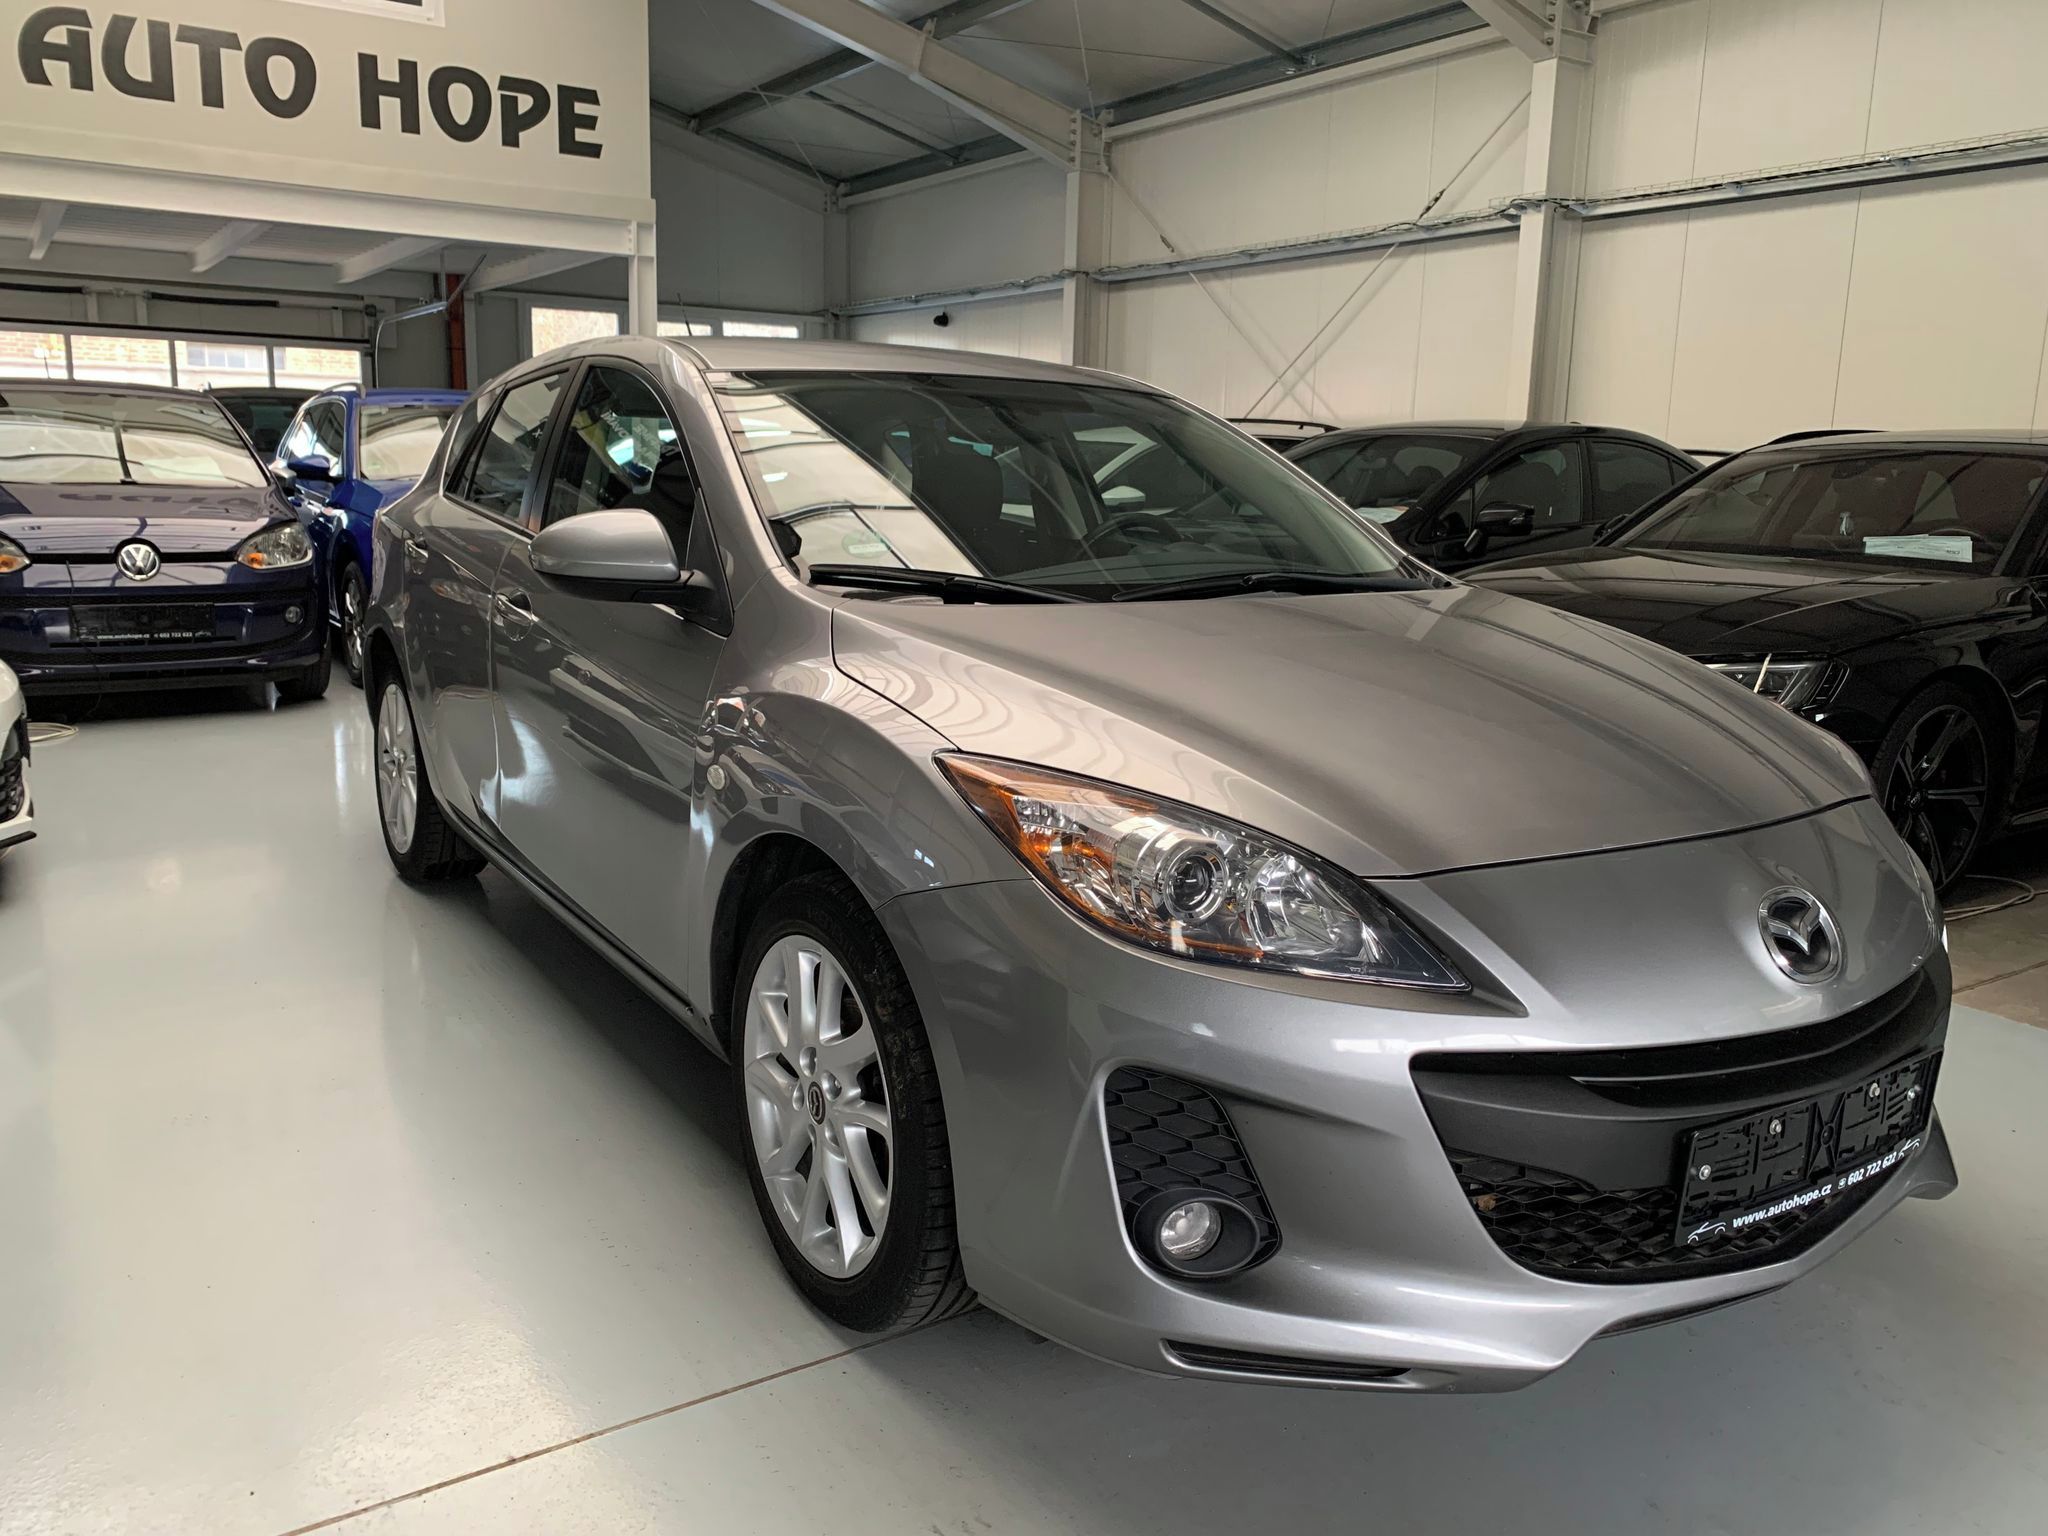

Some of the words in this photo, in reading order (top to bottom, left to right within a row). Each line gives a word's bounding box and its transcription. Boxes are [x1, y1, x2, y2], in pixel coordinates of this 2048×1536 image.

[18, 7, 317, 119] AUTO
[357, 52, 603, 159] HOPE
[1732, 1184, 1832, 1228] www.autohope.cz
[1847, 1168, 1865, 1185] 602
[1866, 1160, 1882, 1177] 722
[1882, 1151, 1897, 1168] 622
